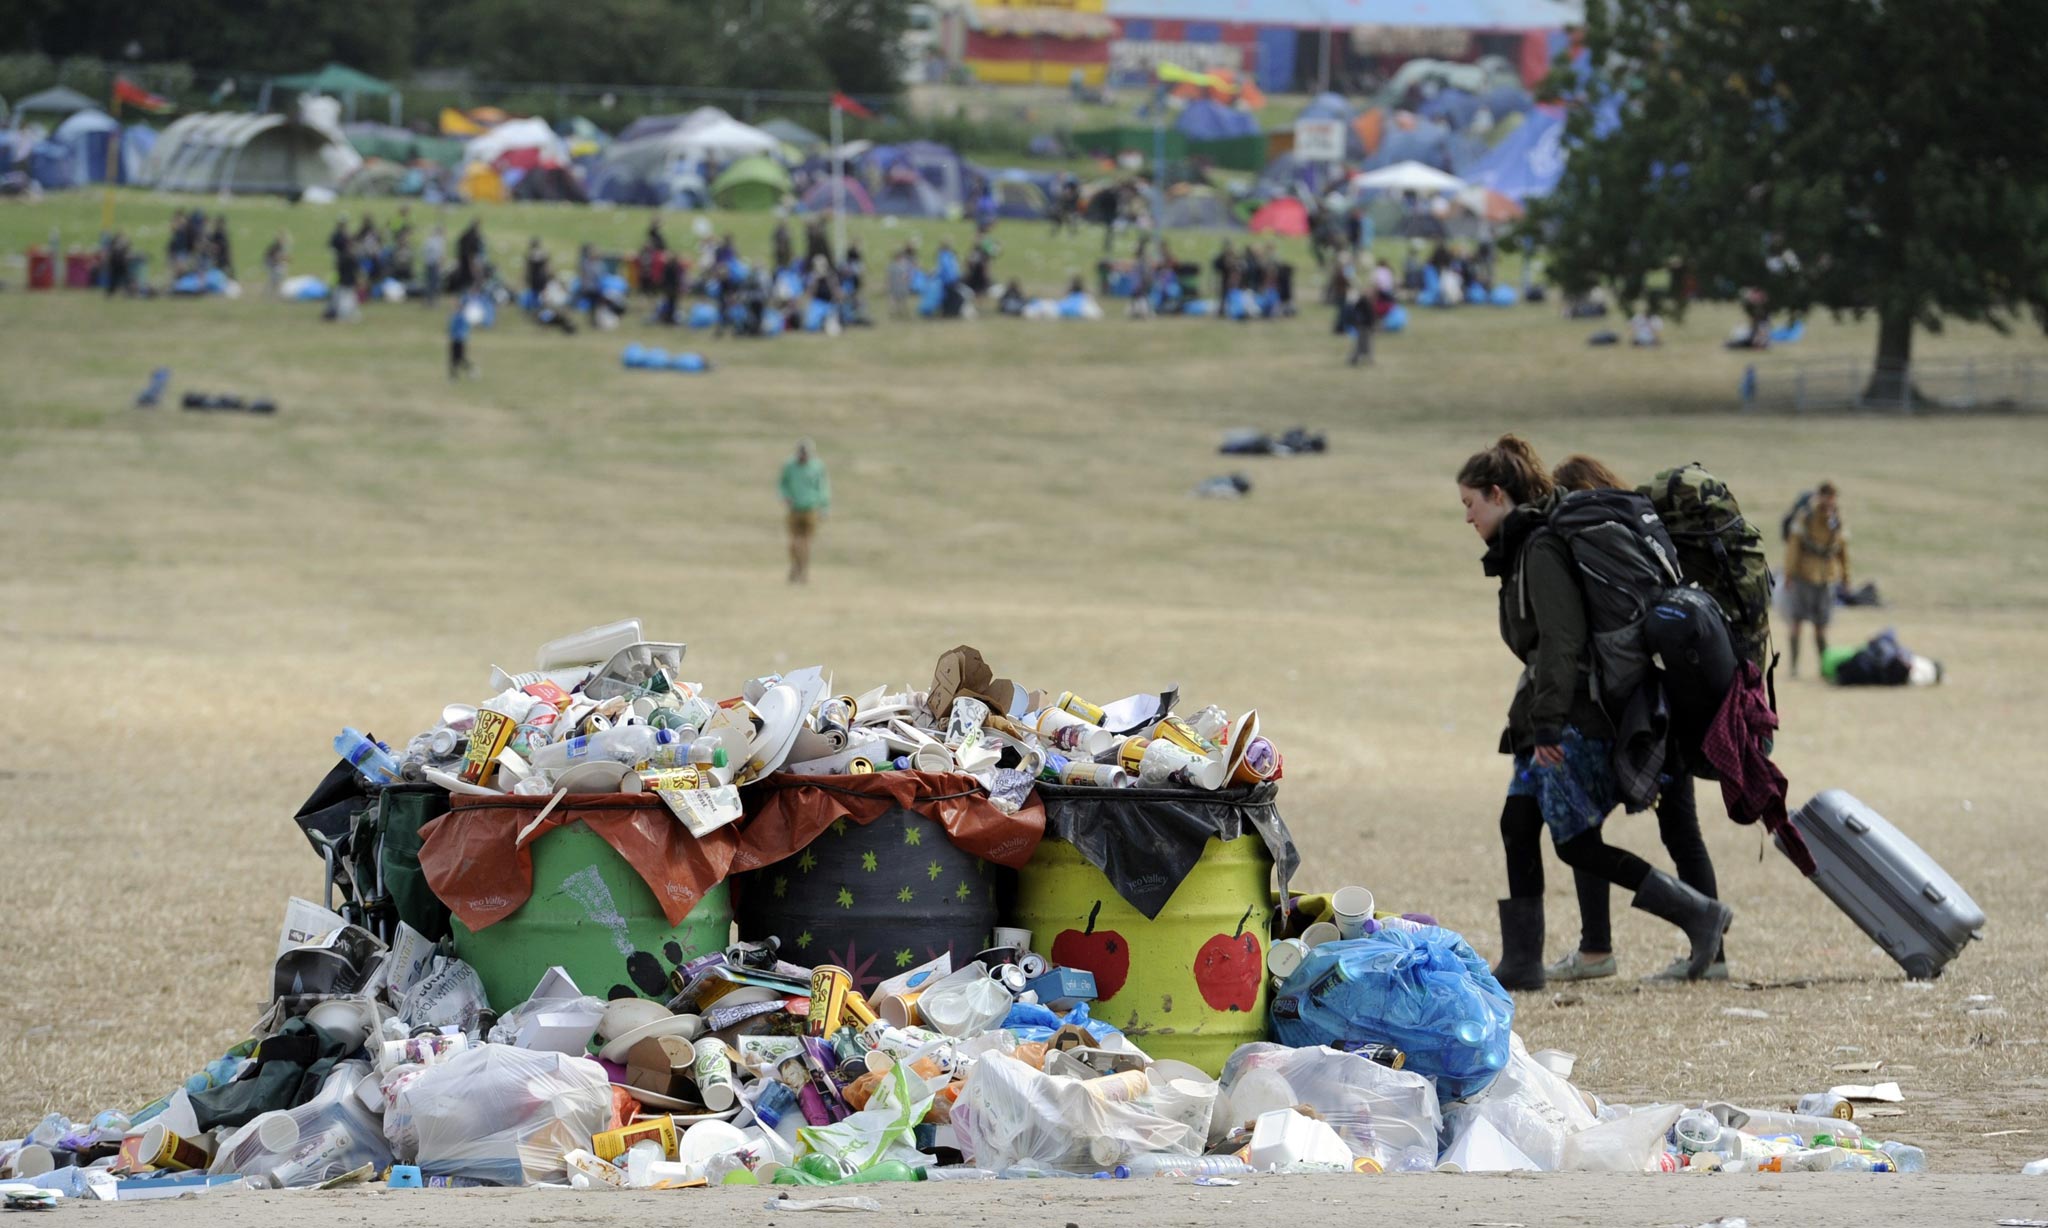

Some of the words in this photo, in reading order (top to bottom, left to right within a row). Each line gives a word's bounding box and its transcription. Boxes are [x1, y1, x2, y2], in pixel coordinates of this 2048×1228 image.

[1142, 873, 1168, 887] Valley
[466, 899, 485, 909] Yeo
[484, 895, 510, 908] Valley
